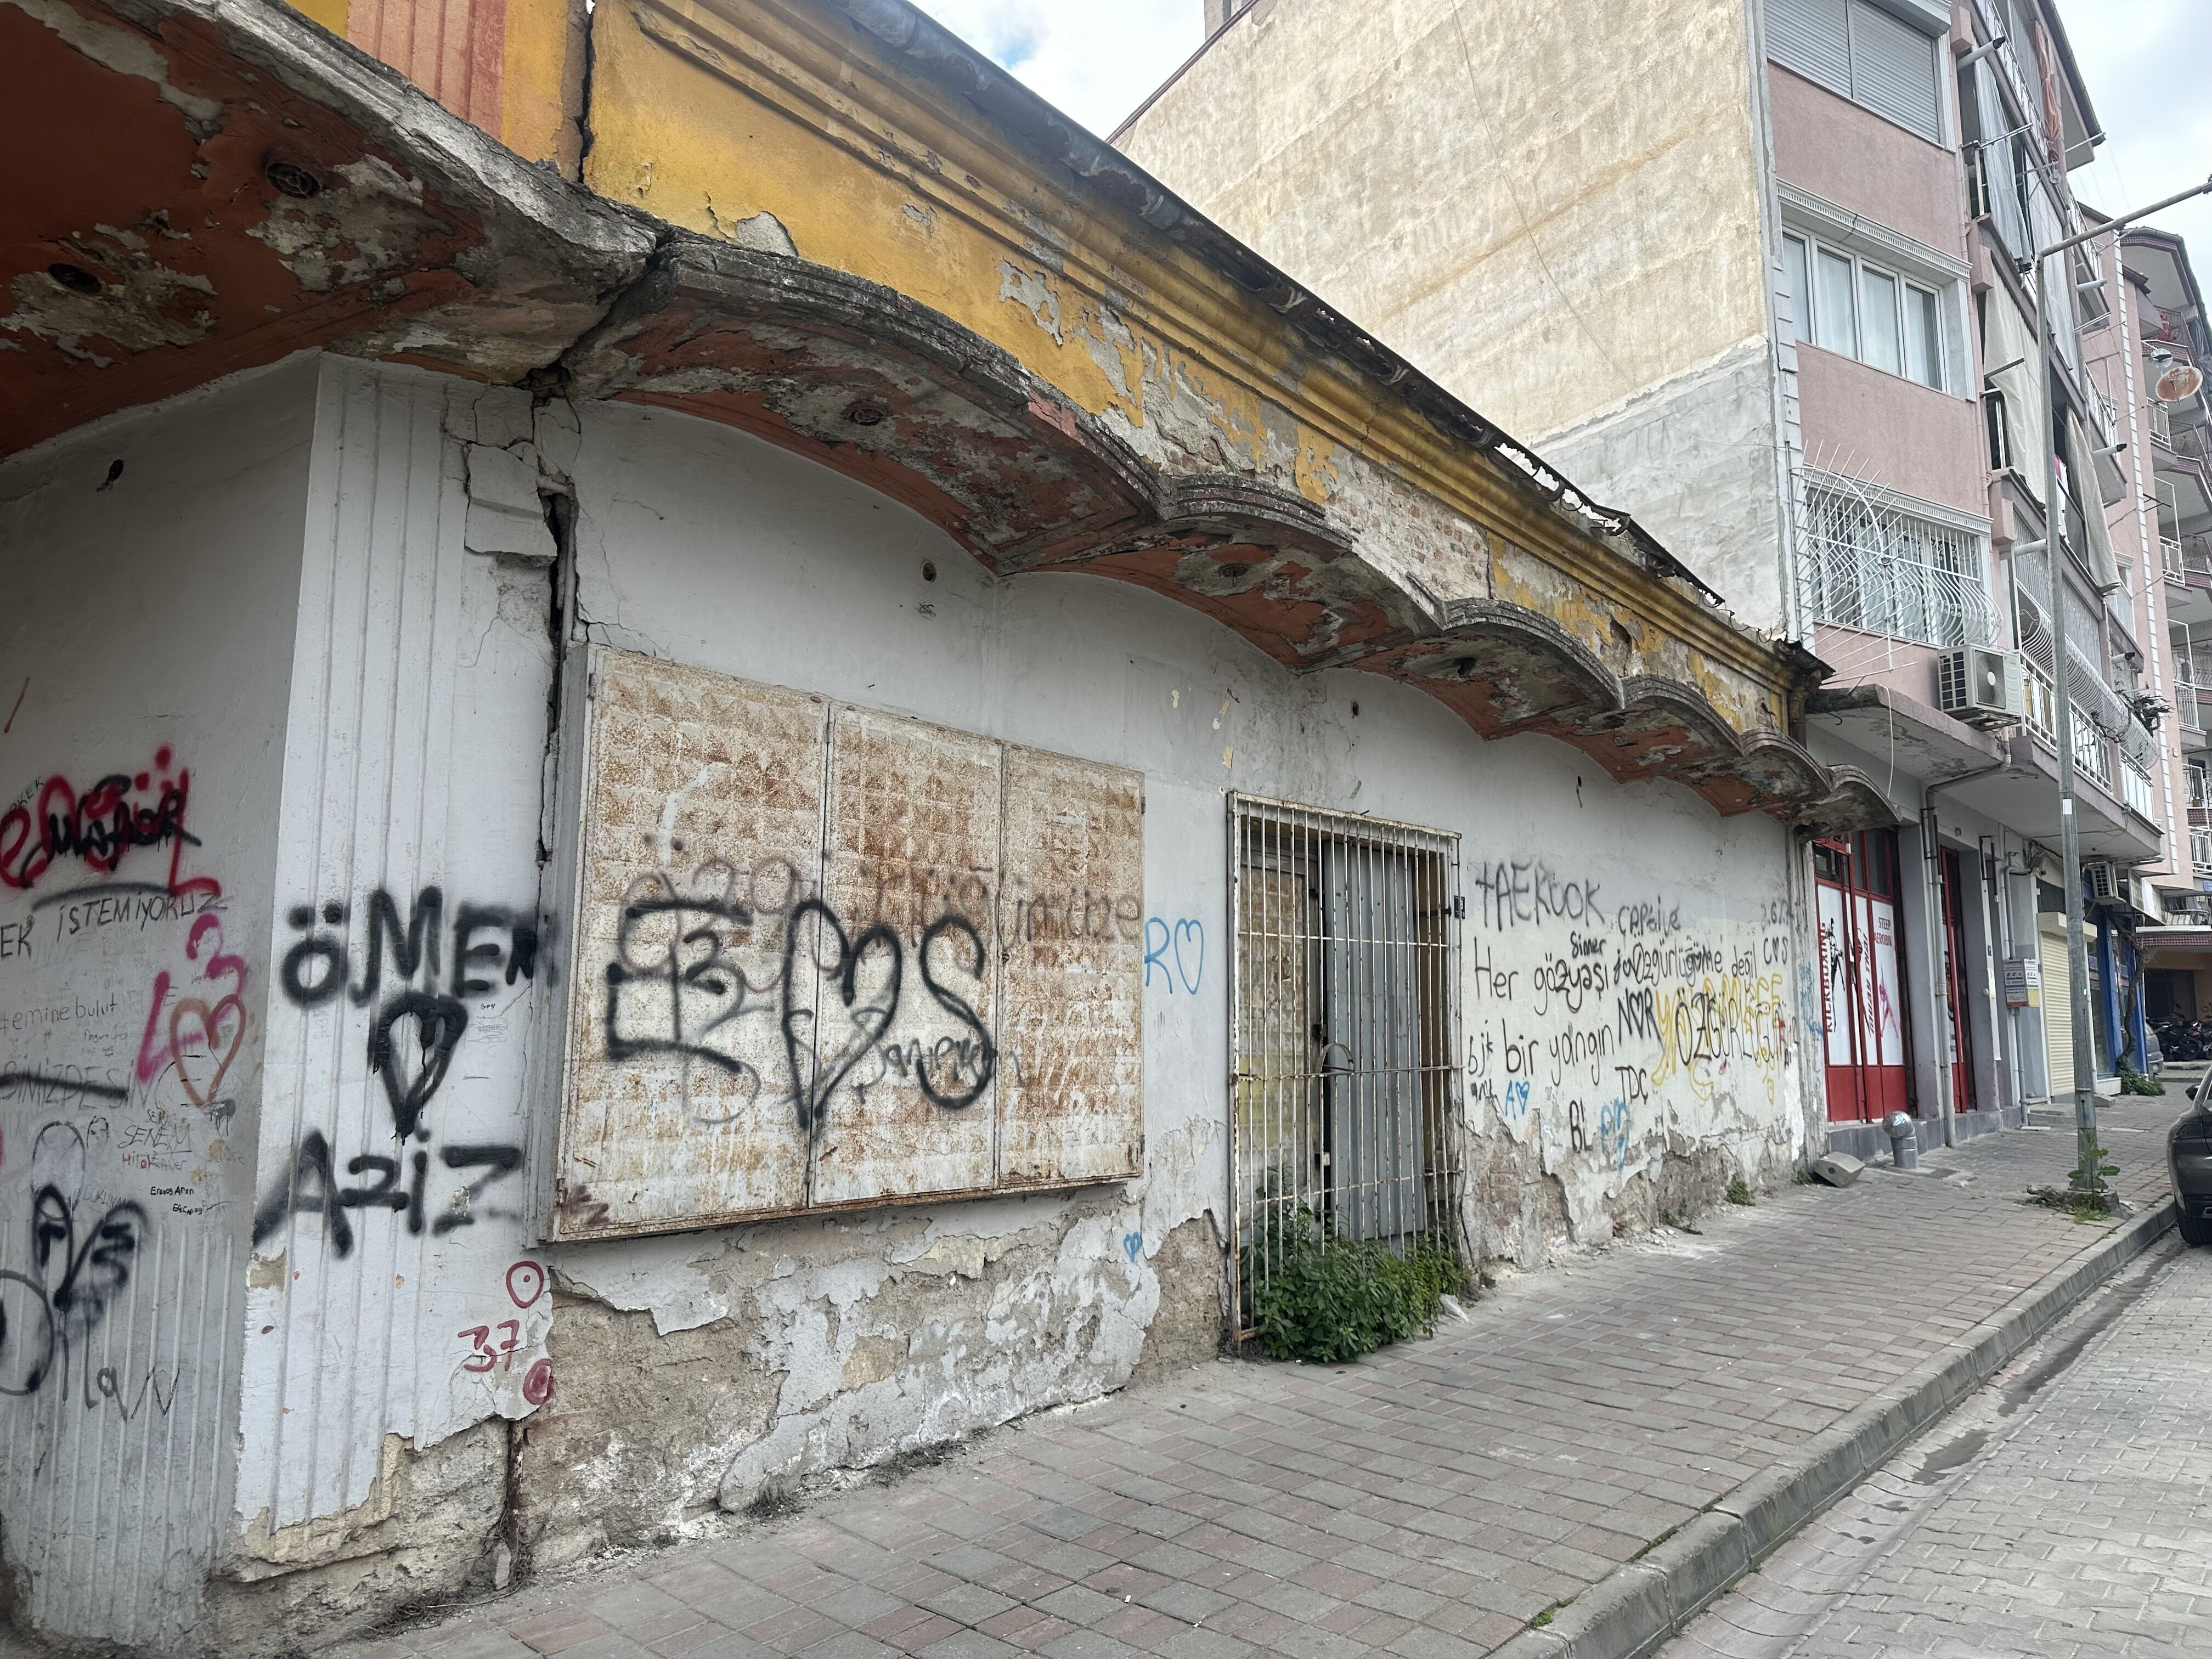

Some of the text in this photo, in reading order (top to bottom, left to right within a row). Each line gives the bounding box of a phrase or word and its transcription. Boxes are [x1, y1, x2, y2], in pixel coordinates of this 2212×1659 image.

[1878, 917, 1891, 930] STEEP
[1474, 936, 1519, 1001] Her
[1534, 952, 1609, 1015] gözyaşı
[1502, 1018, 1614, 1087] bir yangın
